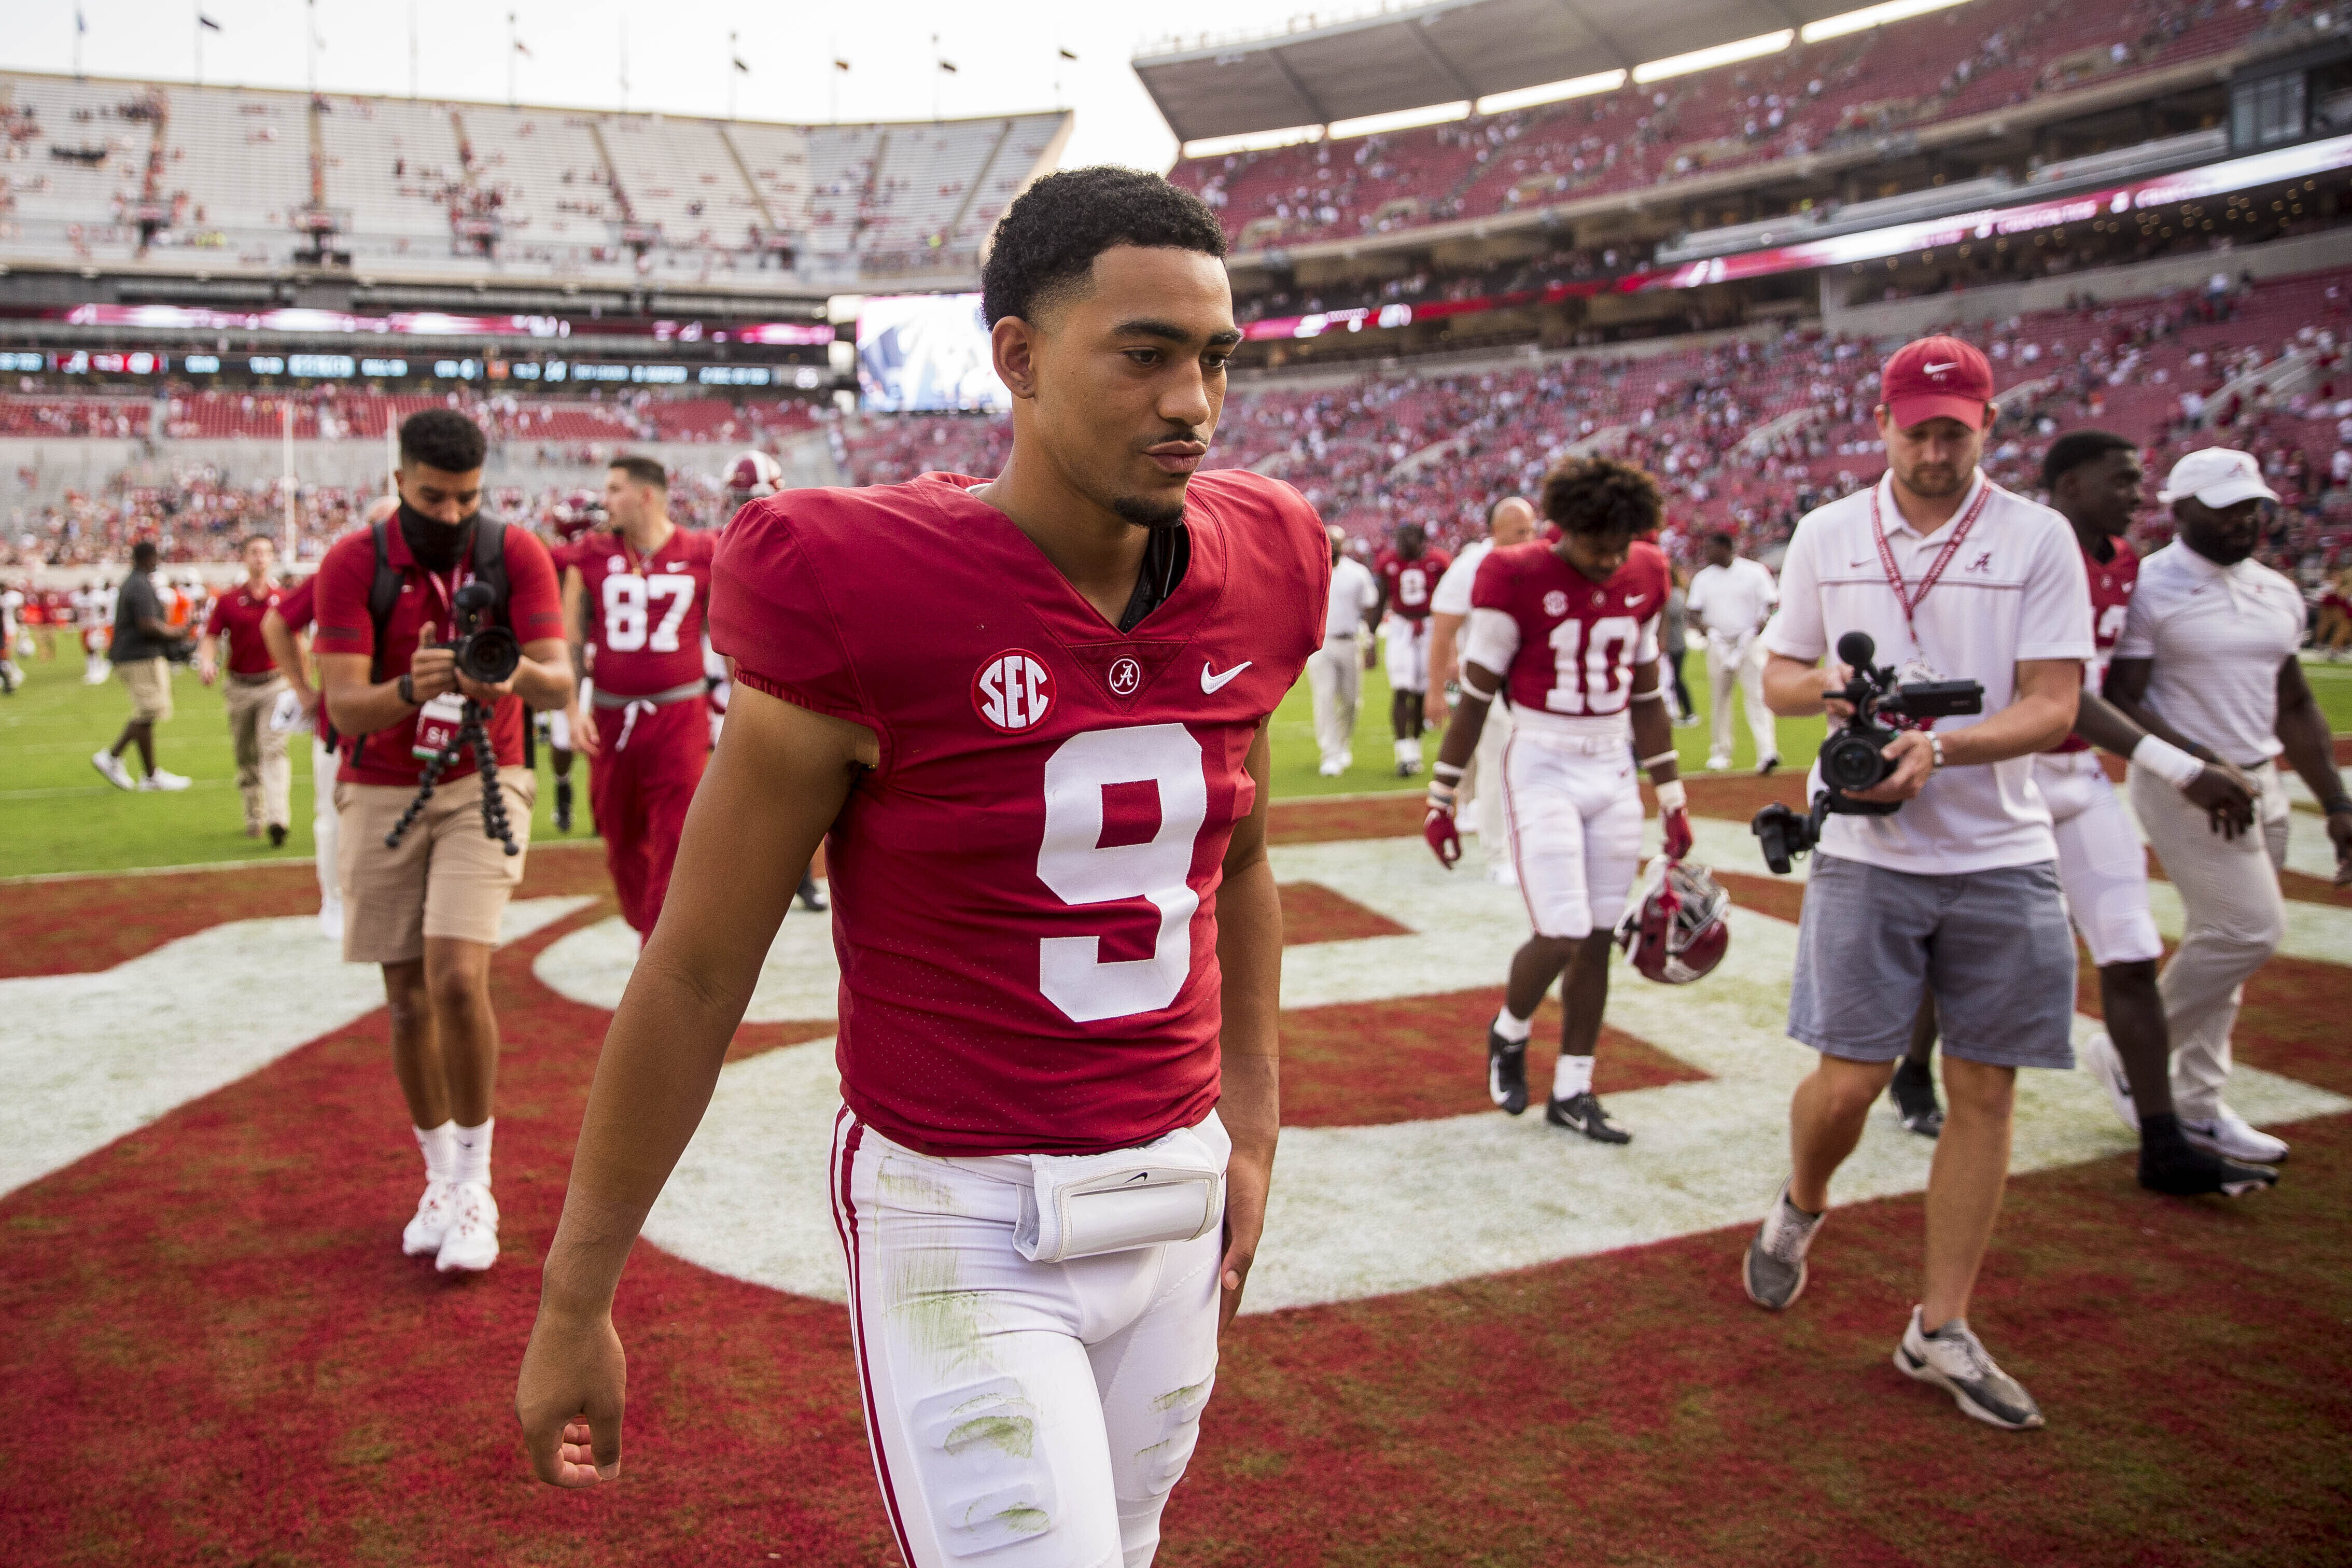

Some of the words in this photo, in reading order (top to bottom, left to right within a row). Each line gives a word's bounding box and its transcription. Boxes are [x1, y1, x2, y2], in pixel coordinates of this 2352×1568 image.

[602, 573, 695, 652] 87
[979, 656, 1049, 728] SEC
[1113, 663, 1134, 687] A
[1545, 615, 1640, 715] 10
[1037, 722, 1207, 1023] 9
